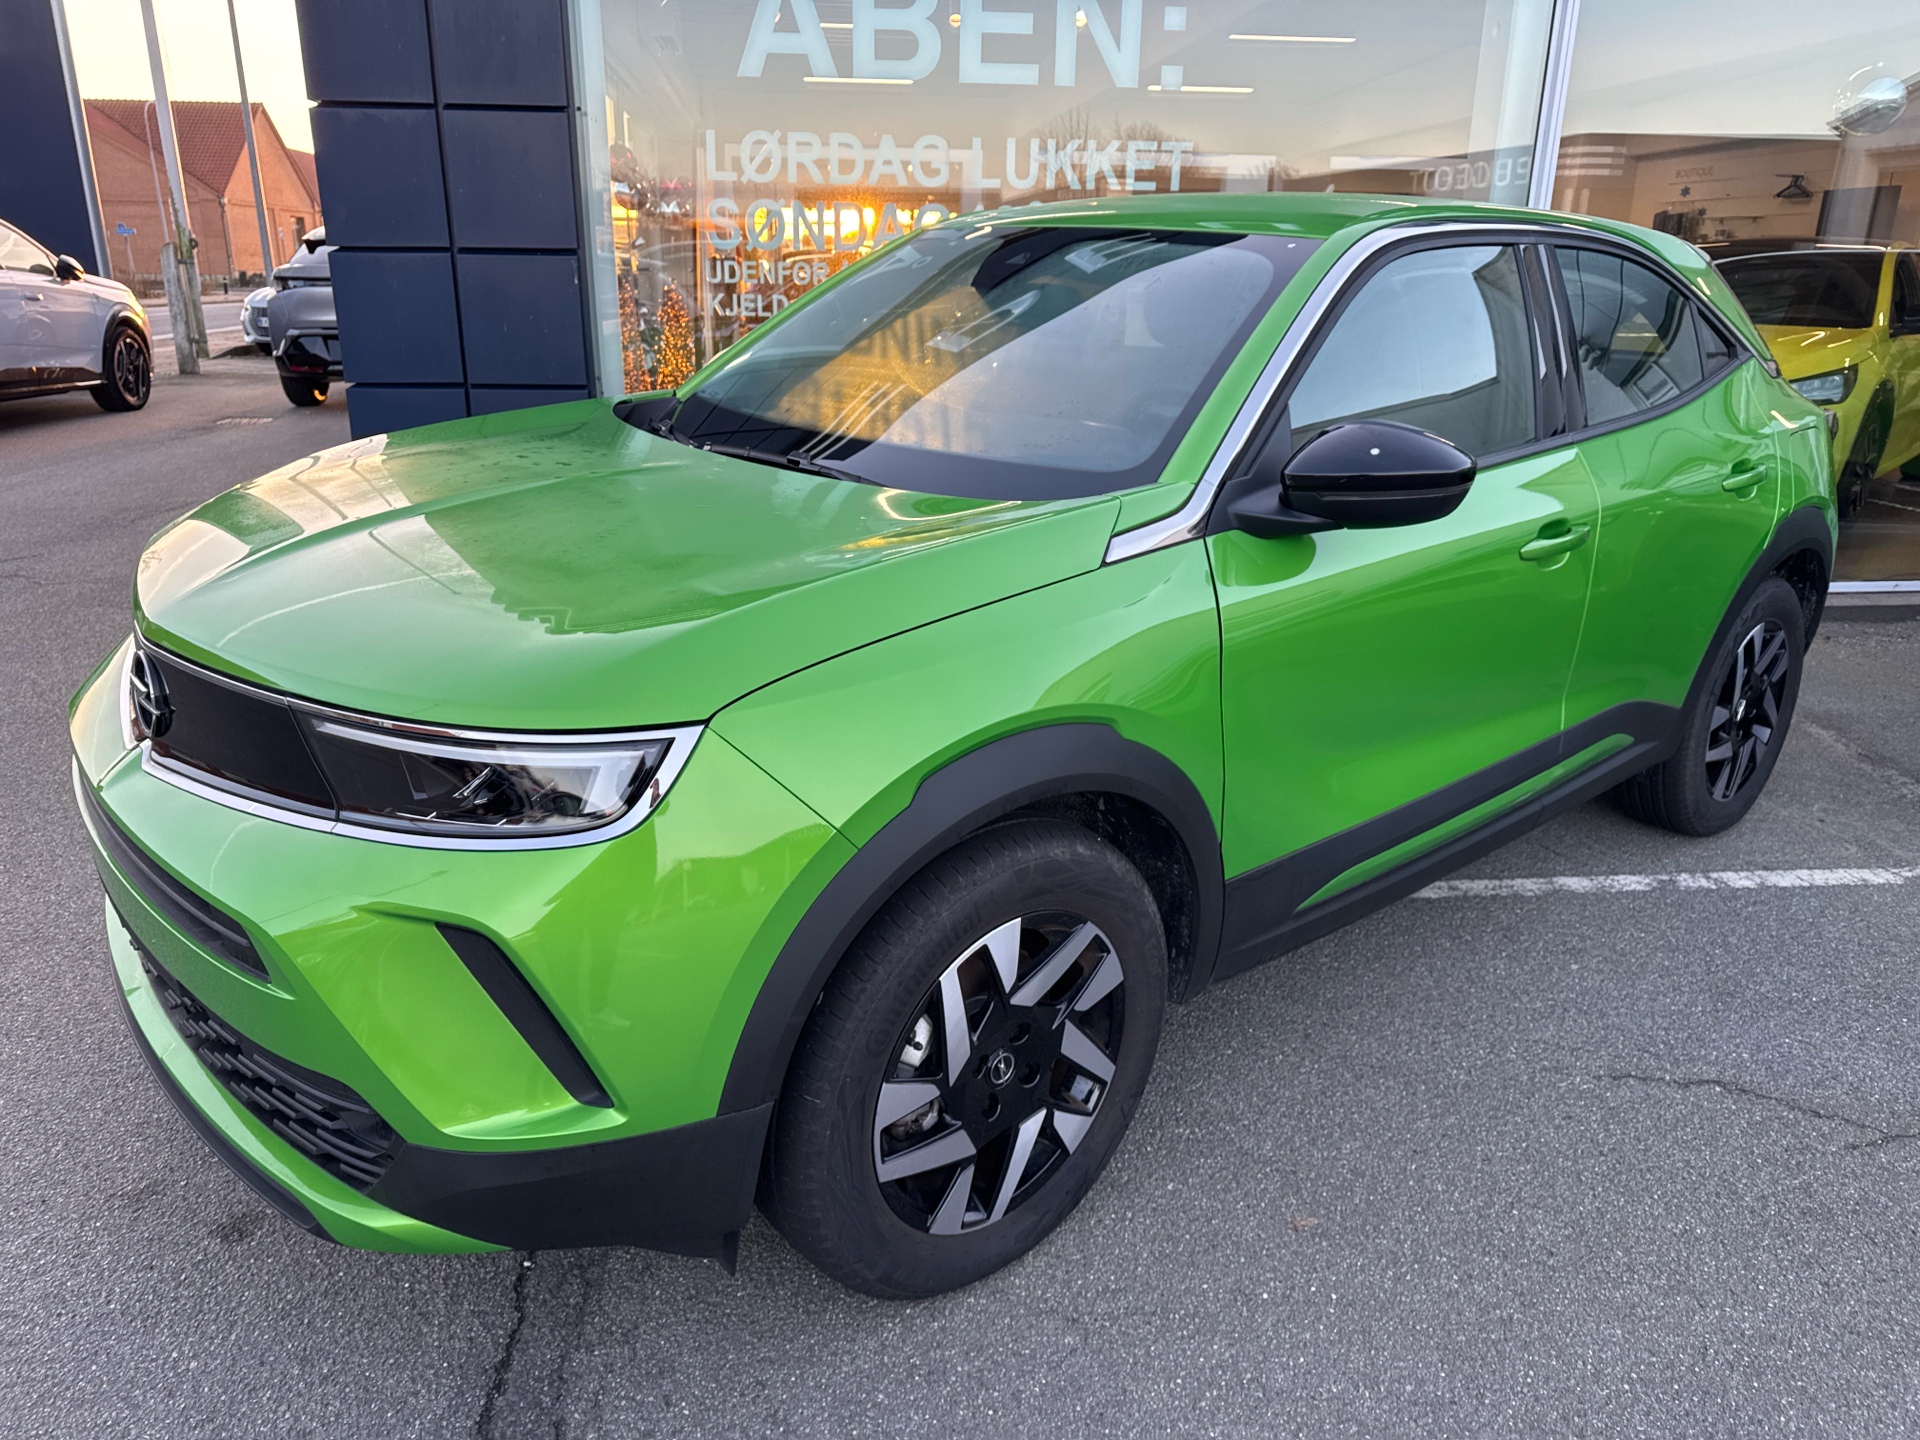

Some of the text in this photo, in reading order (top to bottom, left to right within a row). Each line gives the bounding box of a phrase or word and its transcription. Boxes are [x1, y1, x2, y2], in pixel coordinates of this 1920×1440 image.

[705, 129, 1194, 192] LØRDAG LUKKET
[706, 258, 828, 286] UDENFOR
